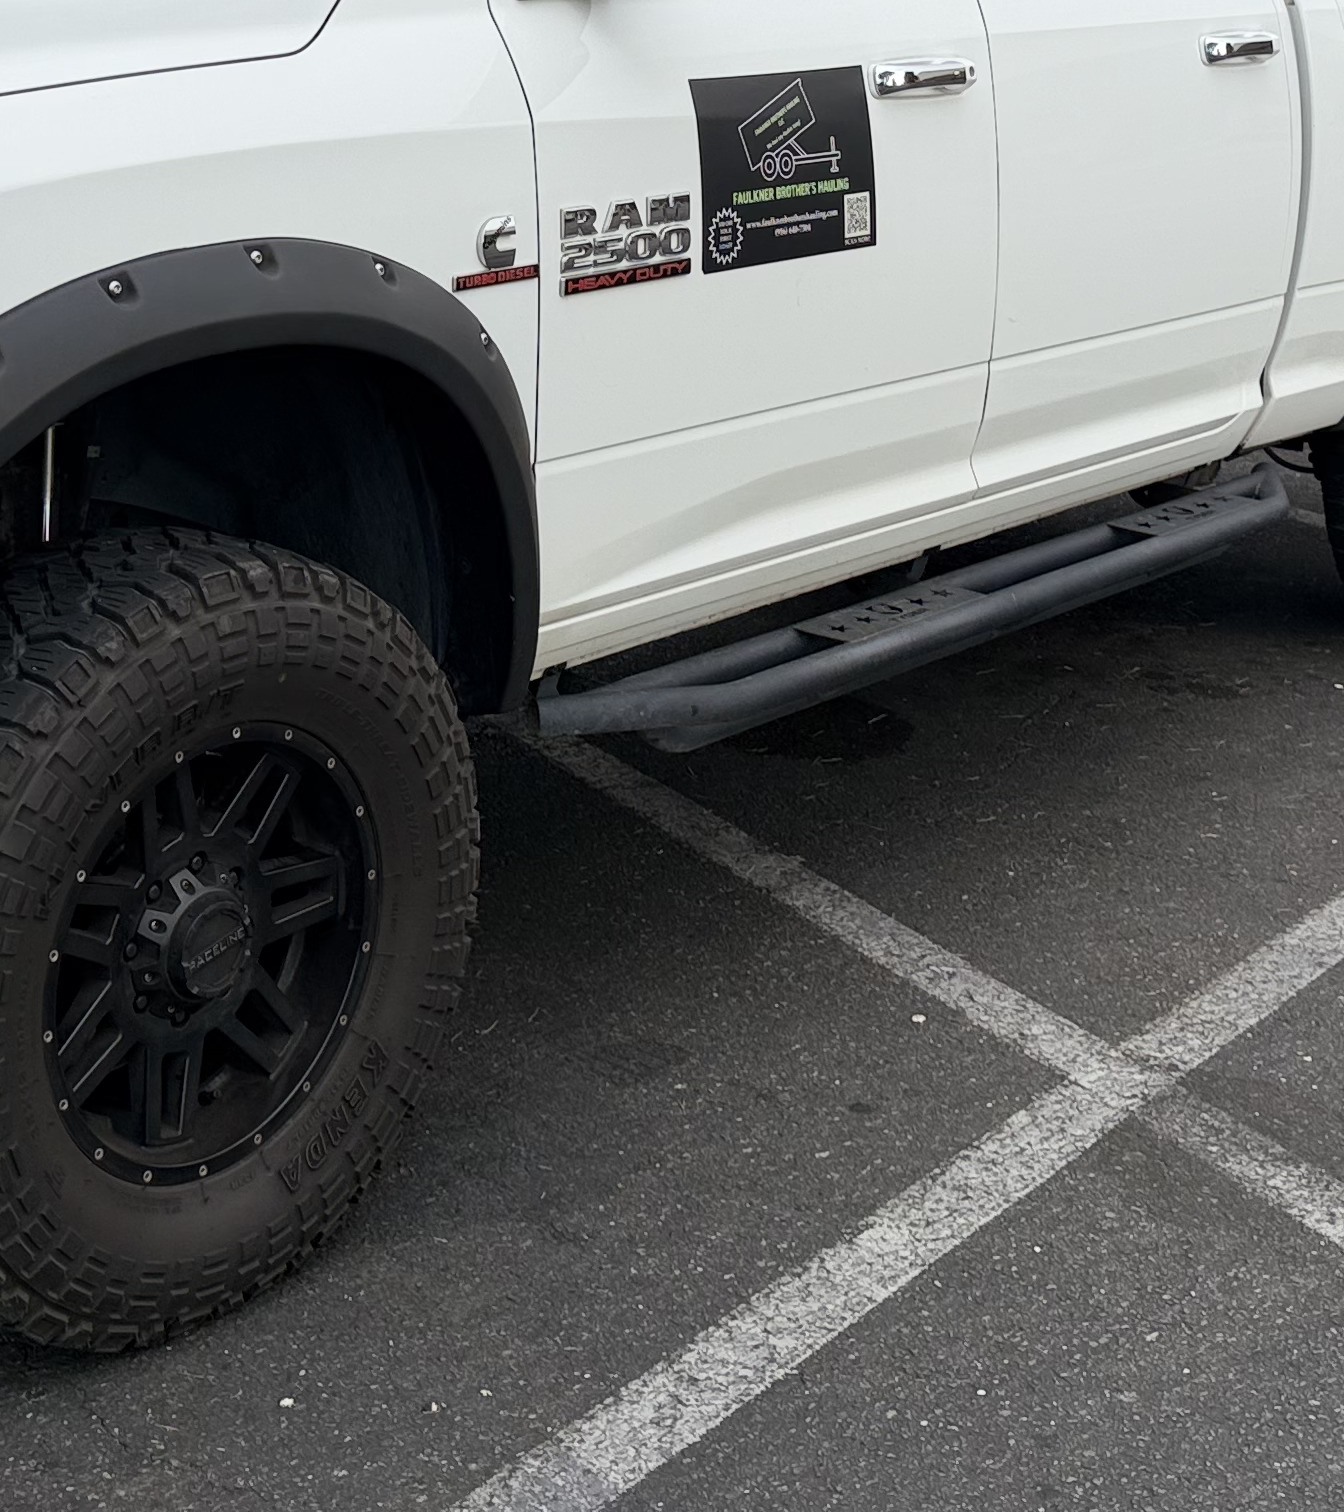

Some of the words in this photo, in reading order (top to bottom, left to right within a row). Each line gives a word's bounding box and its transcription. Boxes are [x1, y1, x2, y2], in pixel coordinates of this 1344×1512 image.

[733, 188, 775, 206] FAULKNER
[775, 181, 817, 200] BROTHER'S
[817, 177, 850, 194] HAULING
[559, 191, 691, 240] RAM
[559, 224, 692, 275] 2500
[457, 270, 497, 290] TURBO
[497, 265, 537, 284] DIESEL
[567, 269, 633, 294] HEAVY
[634, 260, 689, 282] DUTY
[280, 1037, 390, 1191] KENDA
